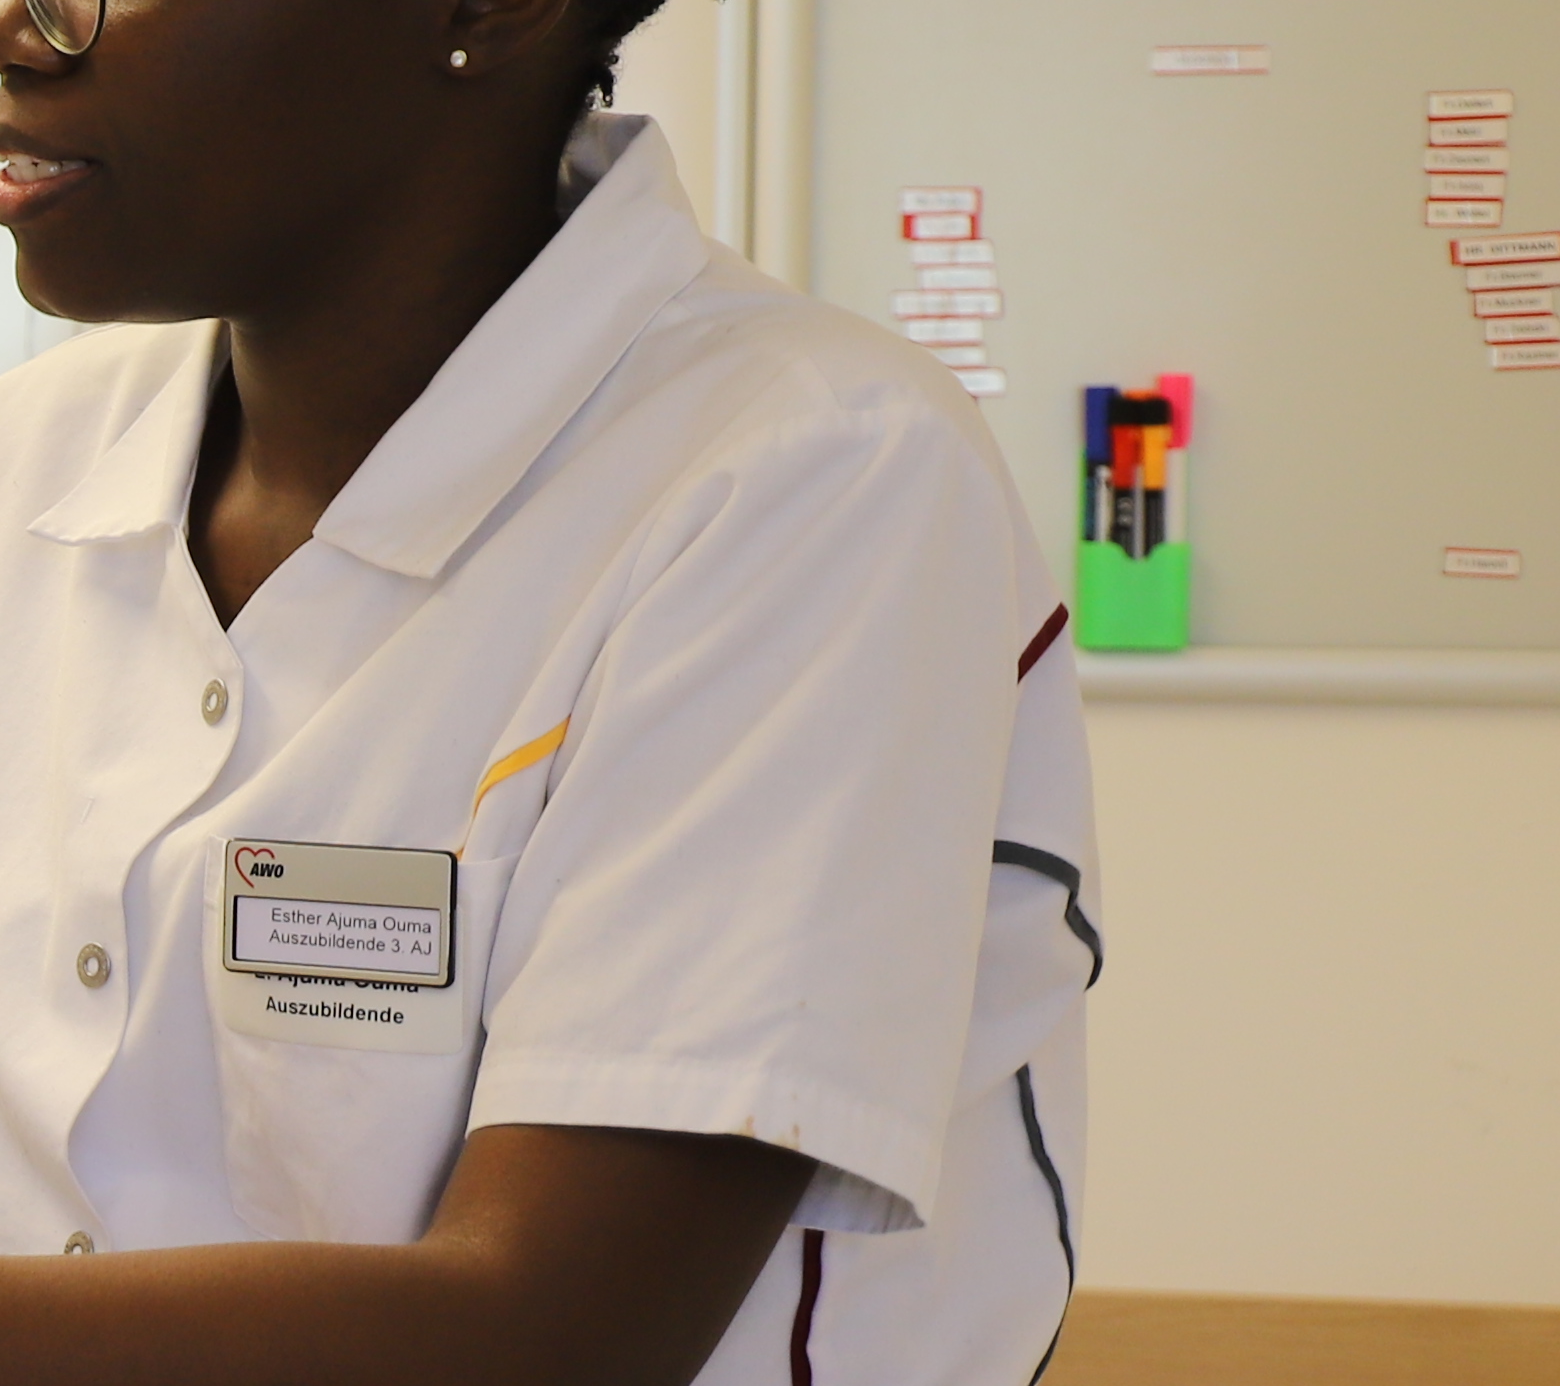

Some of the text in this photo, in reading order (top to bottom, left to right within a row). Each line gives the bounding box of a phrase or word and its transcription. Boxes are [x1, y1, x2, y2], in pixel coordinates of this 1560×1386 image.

[250, 862, 284, 879] AWO
[271, 908, 432, 935] Esther Ajuma Ouma
[269, 929, 432, 956] Auszubildende 3. AJ
[266, 996, 405, 1025] Auszubildende
